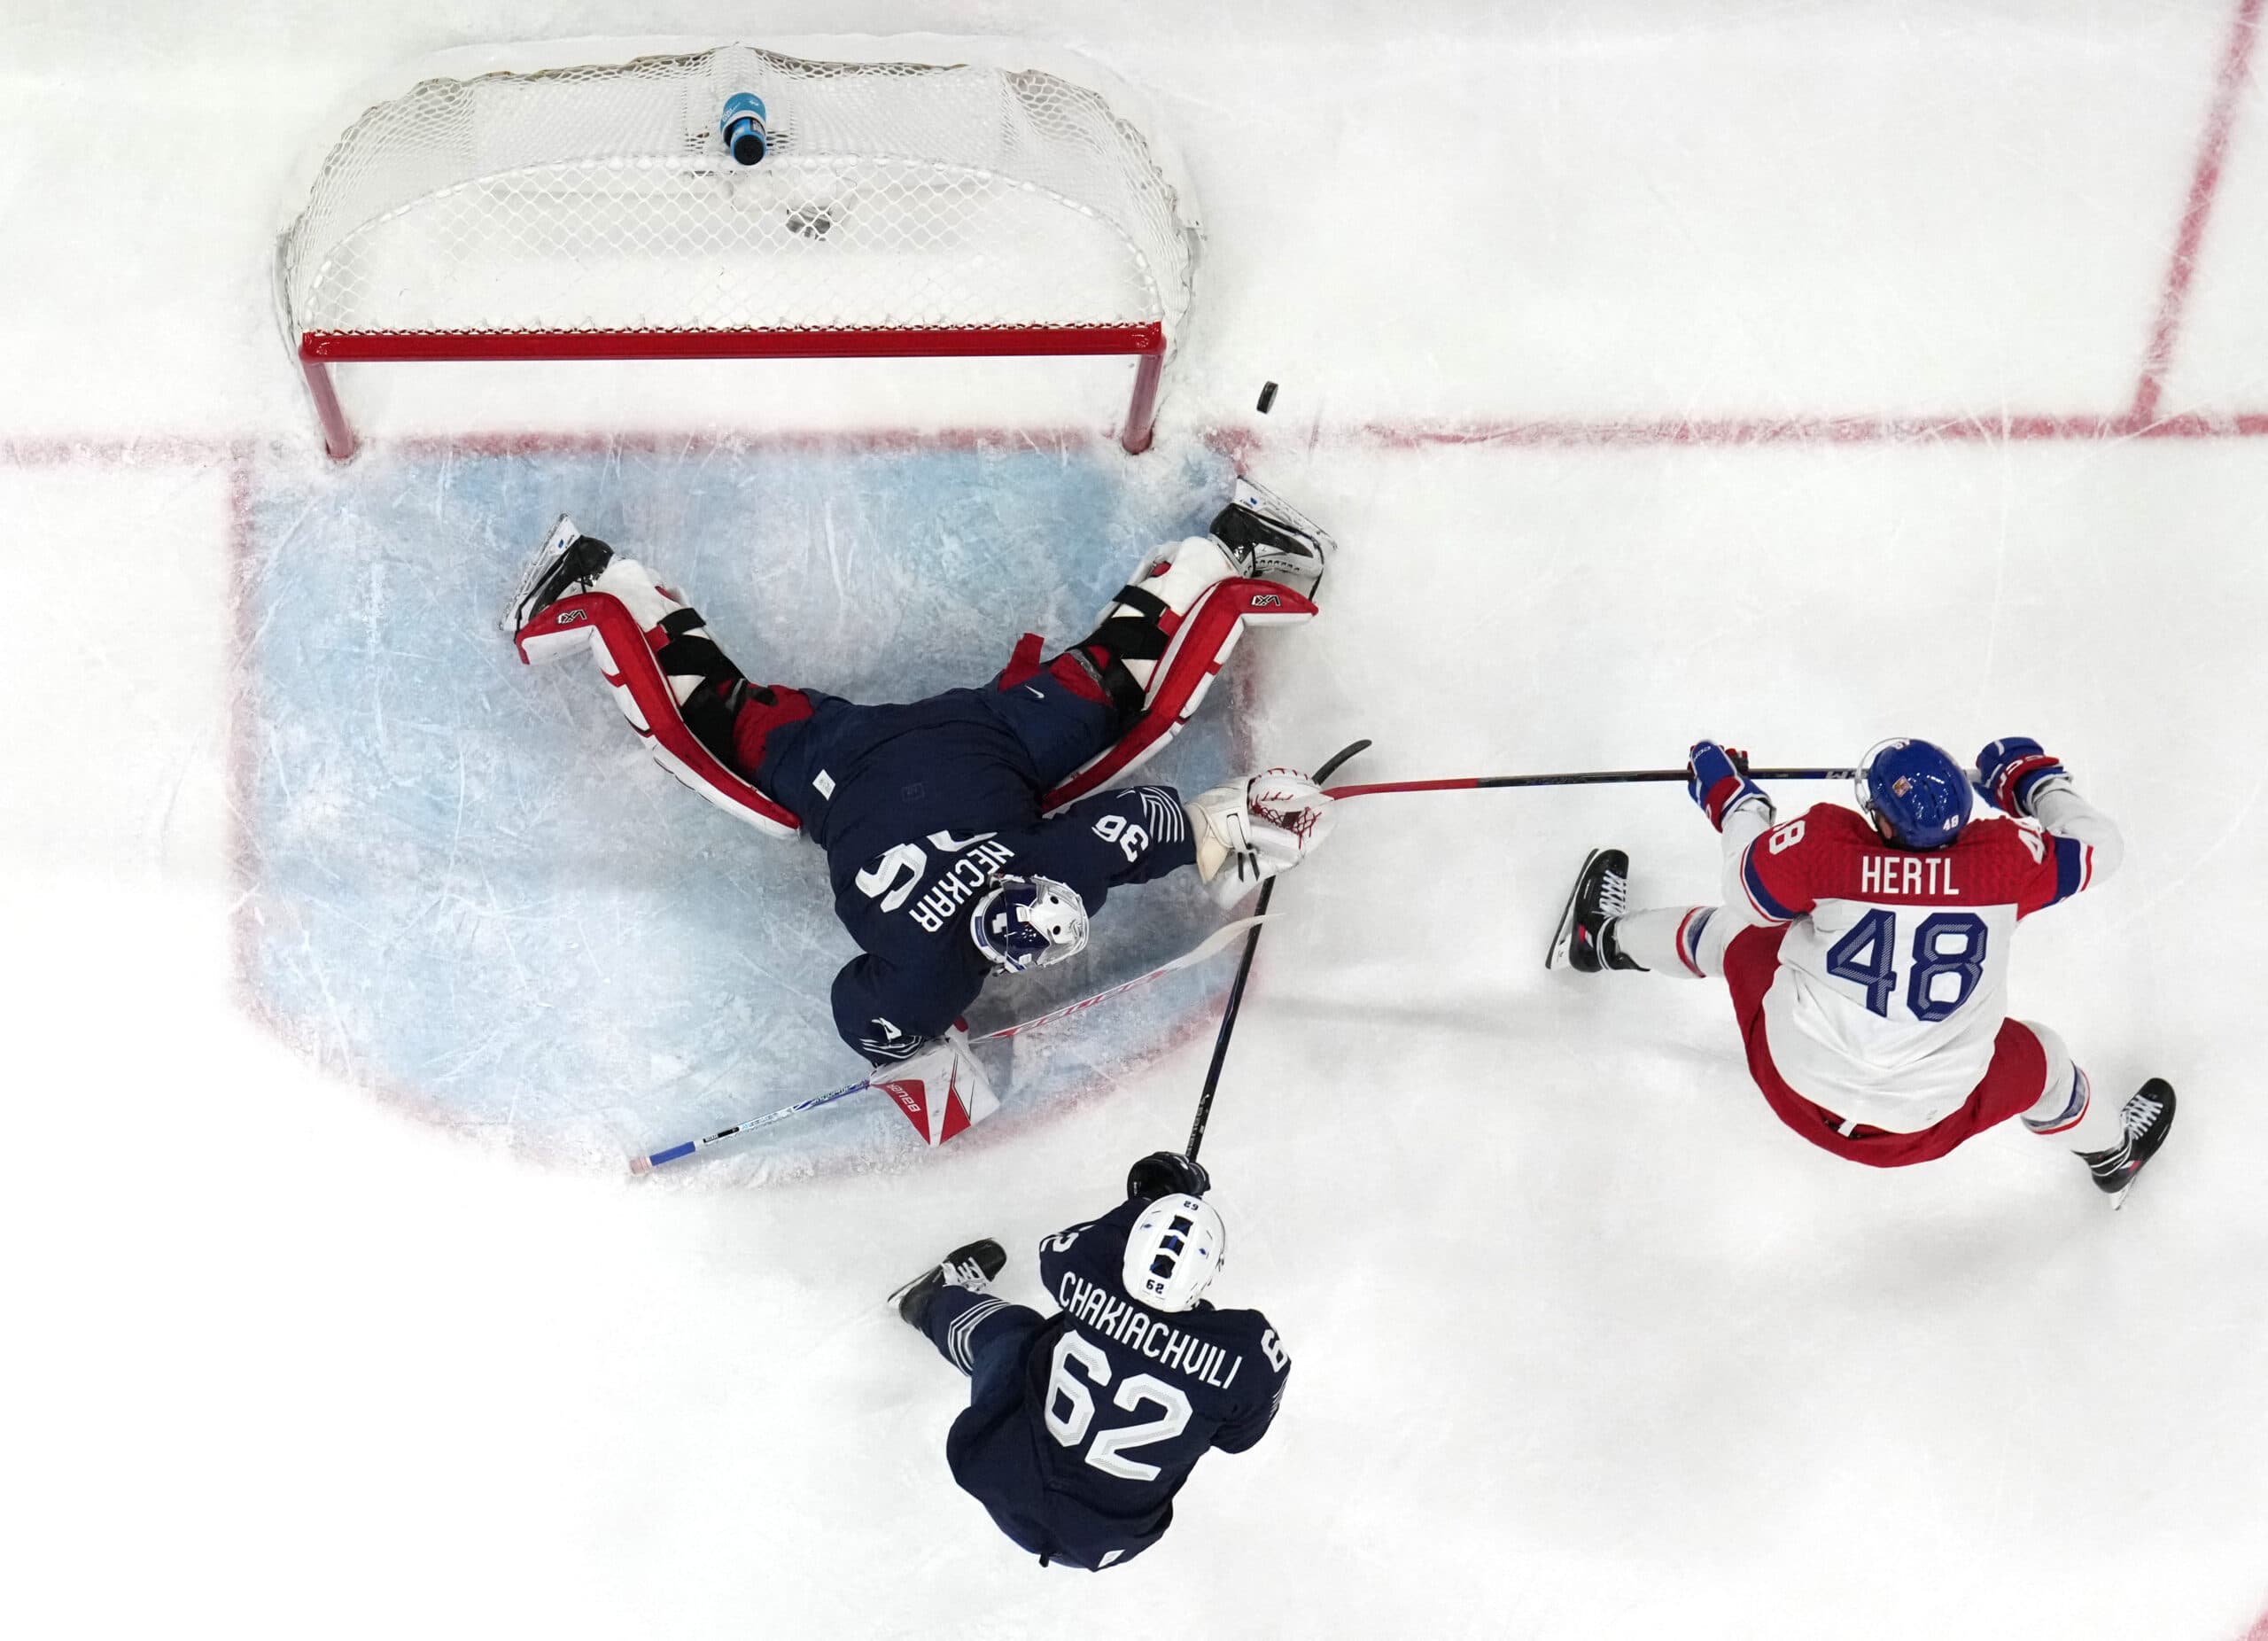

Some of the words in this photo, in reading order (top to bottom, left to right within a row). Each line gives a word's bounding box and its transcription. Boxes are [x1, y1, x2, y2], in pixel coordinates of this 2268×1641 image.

[1091, 814, 1149, 863] 36
[1768, 819, 1806, 856] 8
[1940, 814, 1960, 831] 48
[908, 840, 1015, 933] NECKAR
[1861, 855, 1960, 895] HERTL
[1826, 908, 1988, 1023] 48
[1146, 1279, 1164, 1295] 62
[1059, 1271, 1243, 1389] CHAKIACHVILI
[1045, 1329, 1193, 1482] 62
